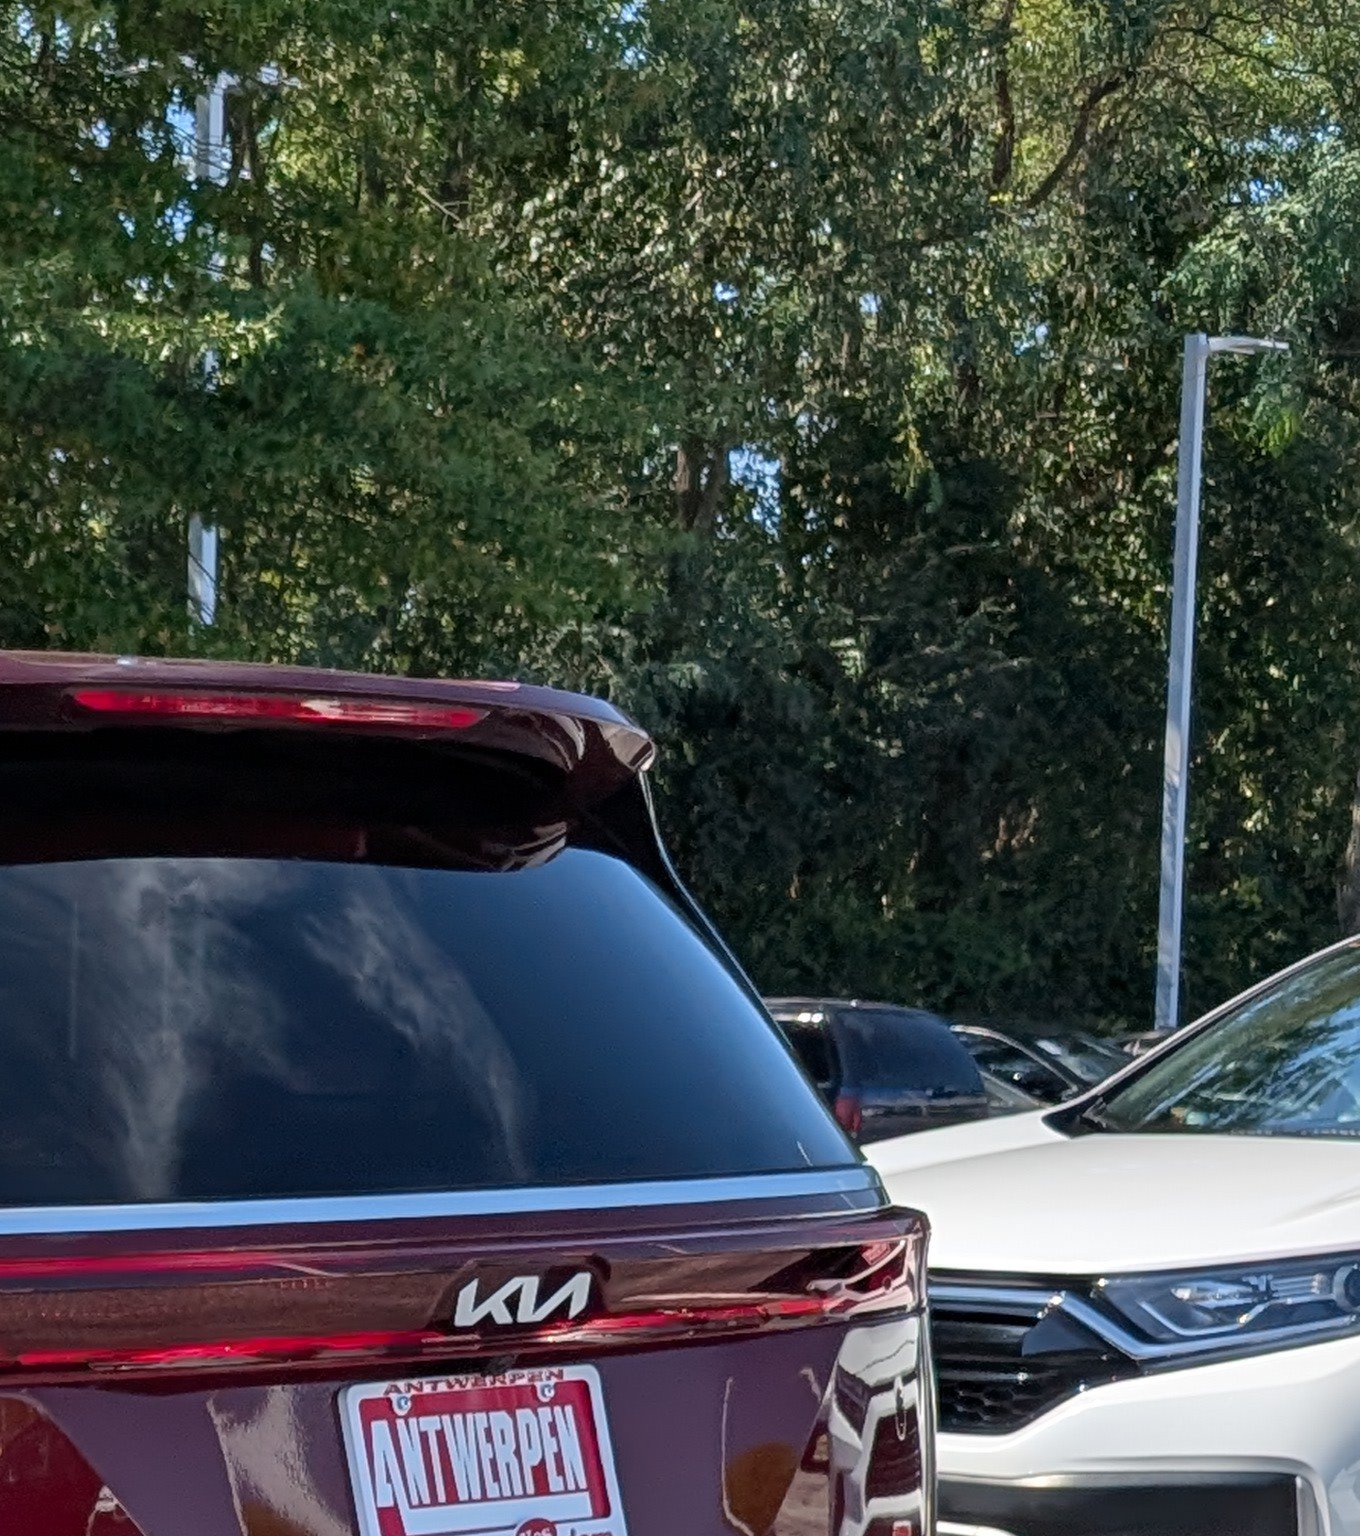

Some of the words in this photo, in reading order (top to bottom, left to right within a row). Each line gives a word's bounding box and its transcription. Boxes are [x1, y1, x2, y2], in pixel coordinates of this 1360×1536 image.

[454, 1271, 591, 1327] KIA
[383, 1368, 565, 1396] ANTWERPEN
[370, 1405, 588, 1508] ANTWERPEN
